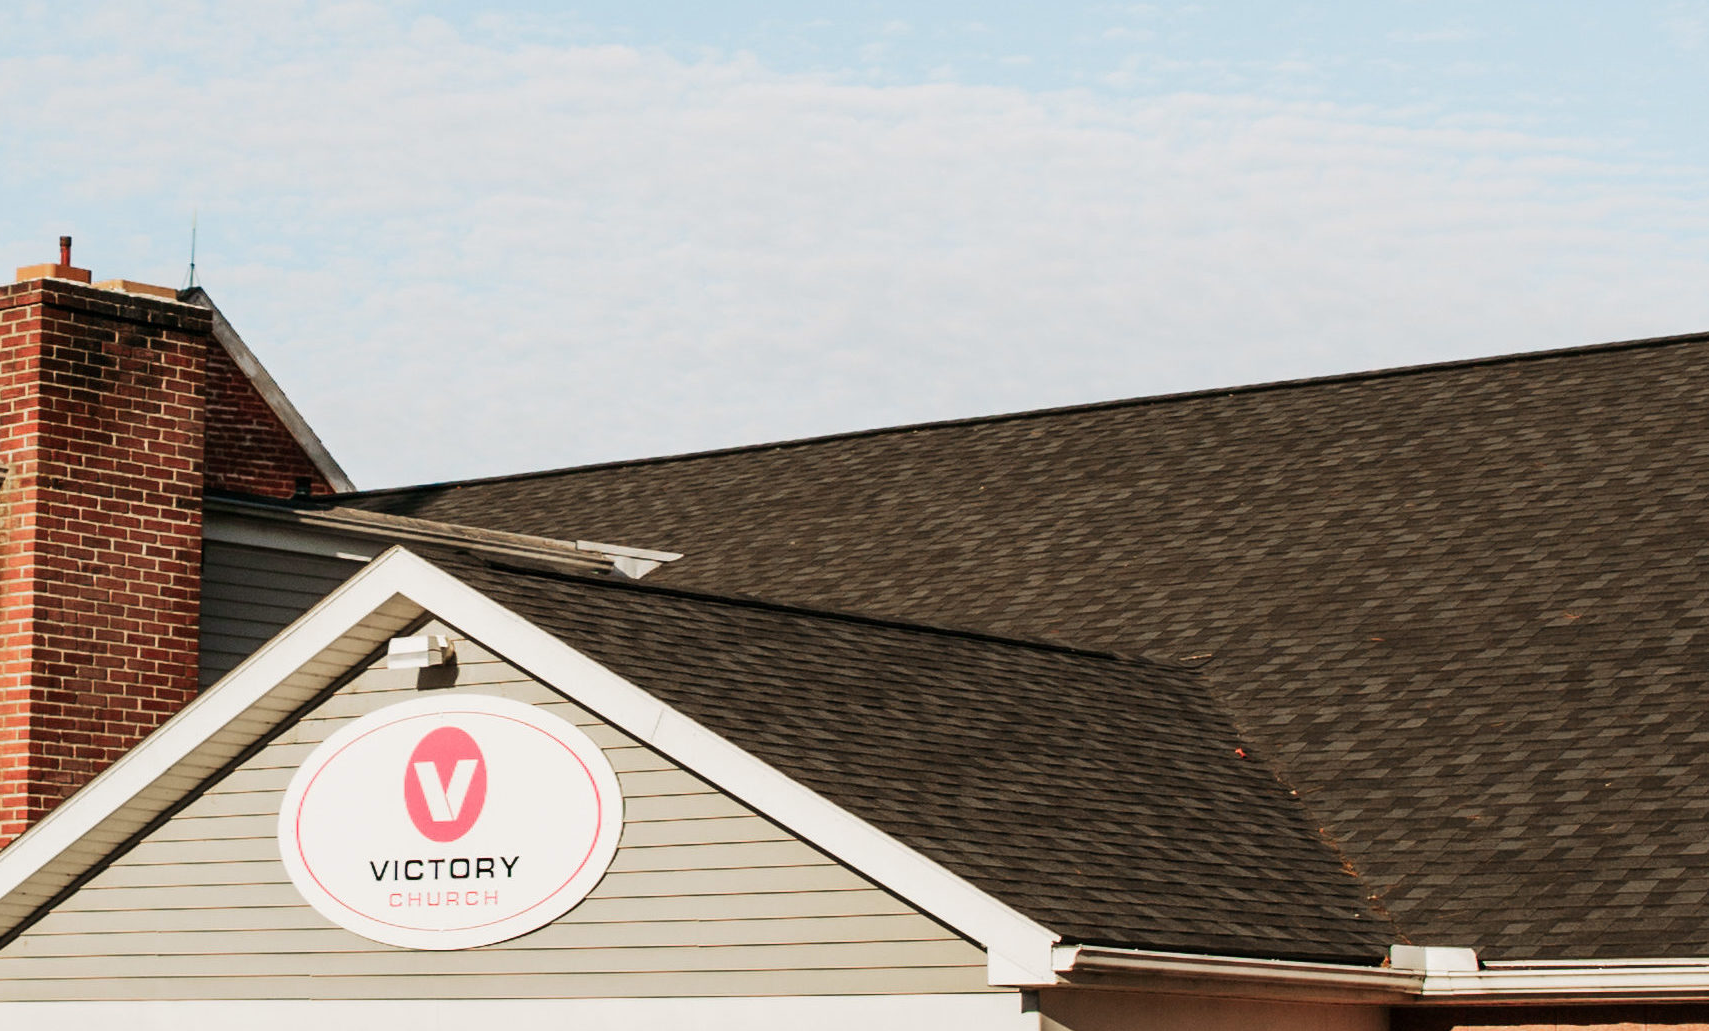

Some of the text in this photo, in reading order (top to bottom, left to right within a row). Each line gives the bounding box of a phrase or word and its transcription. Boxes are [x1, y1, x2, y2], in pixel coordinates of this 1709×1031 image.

[414, 759, 478, 822] V
[369, 856, 519, 881] VICTORY
[388, 890, 498, 907] CHURCH
